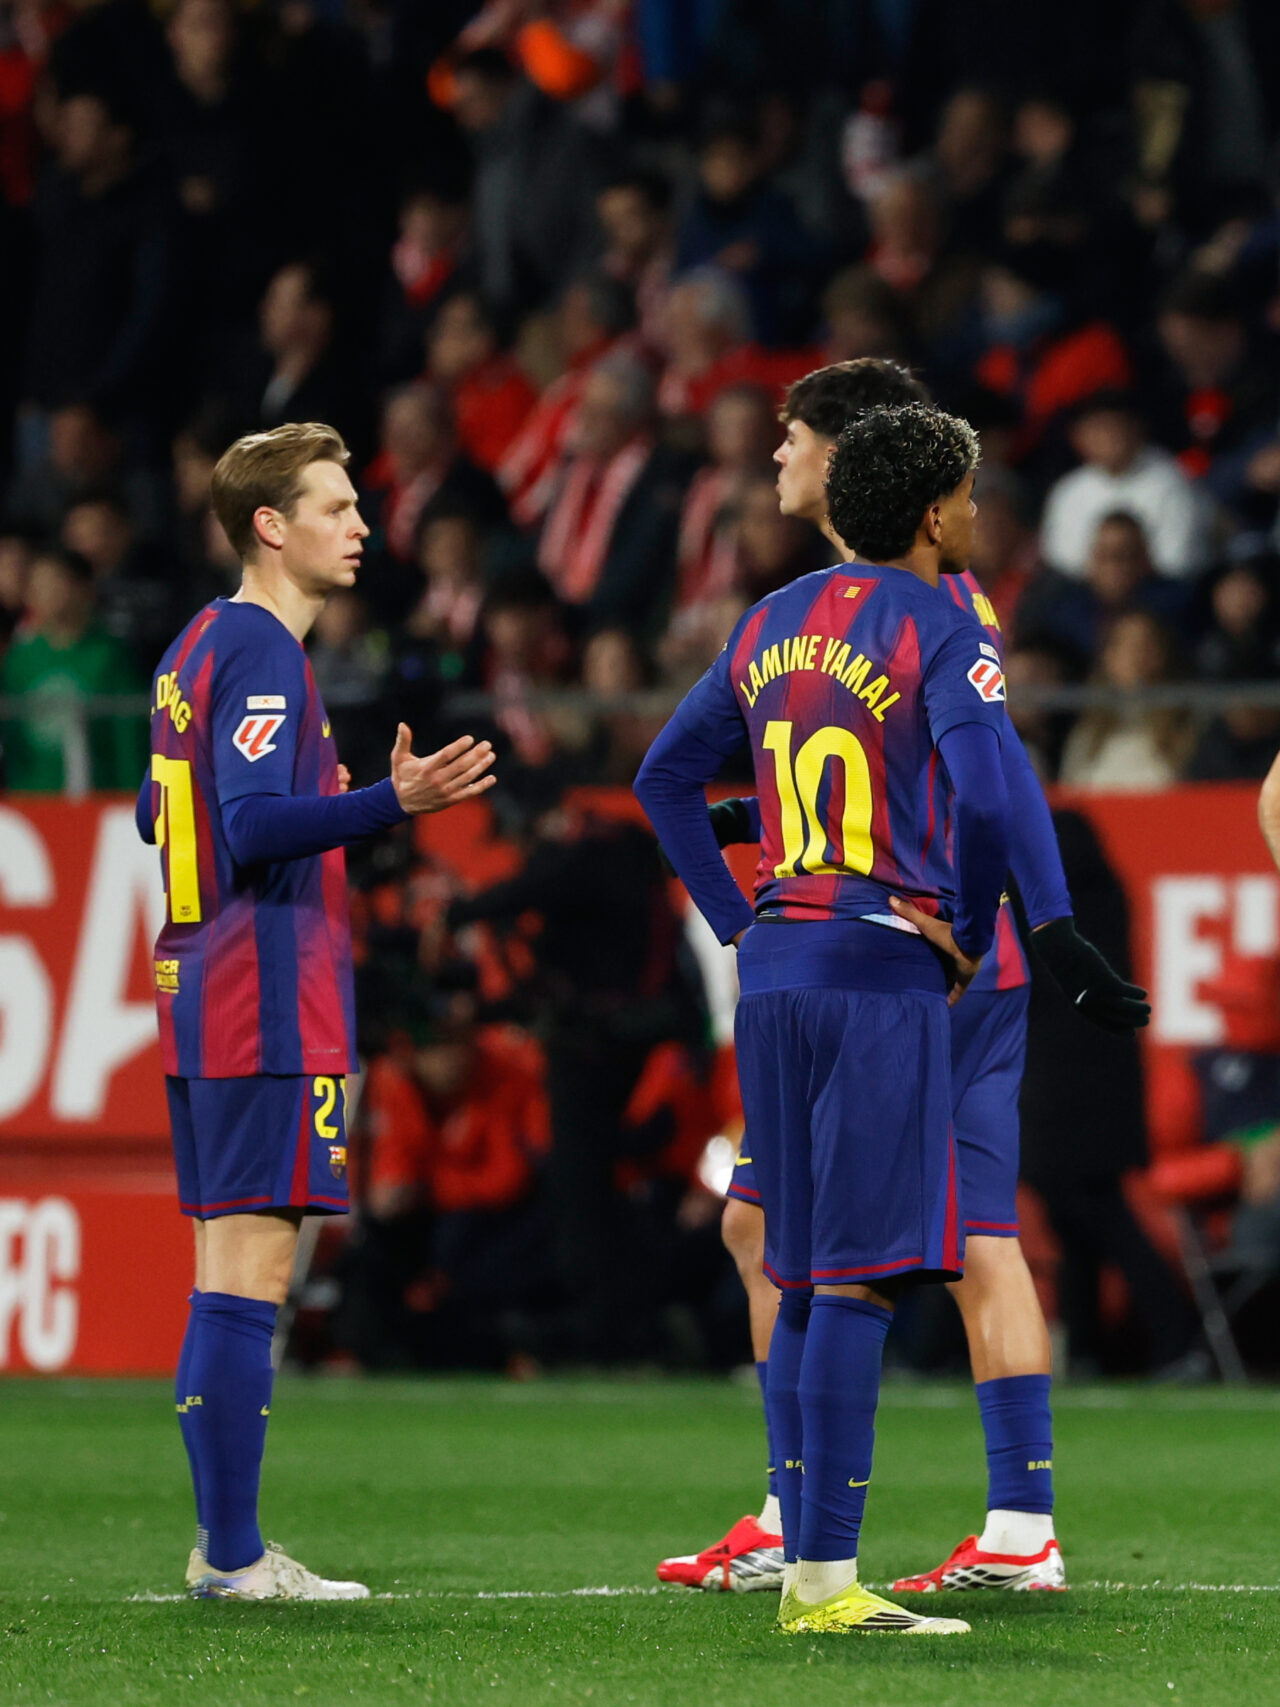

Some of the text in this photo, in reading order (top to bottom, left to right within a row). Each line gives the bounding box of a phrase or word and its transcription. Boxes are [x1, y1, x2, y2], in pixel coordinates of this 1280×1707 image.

[739, 635, 901, 723] LAMINE YAMAL
[762, 721, 874, 879] 10
[313, 1075, 348, 1140] 2
